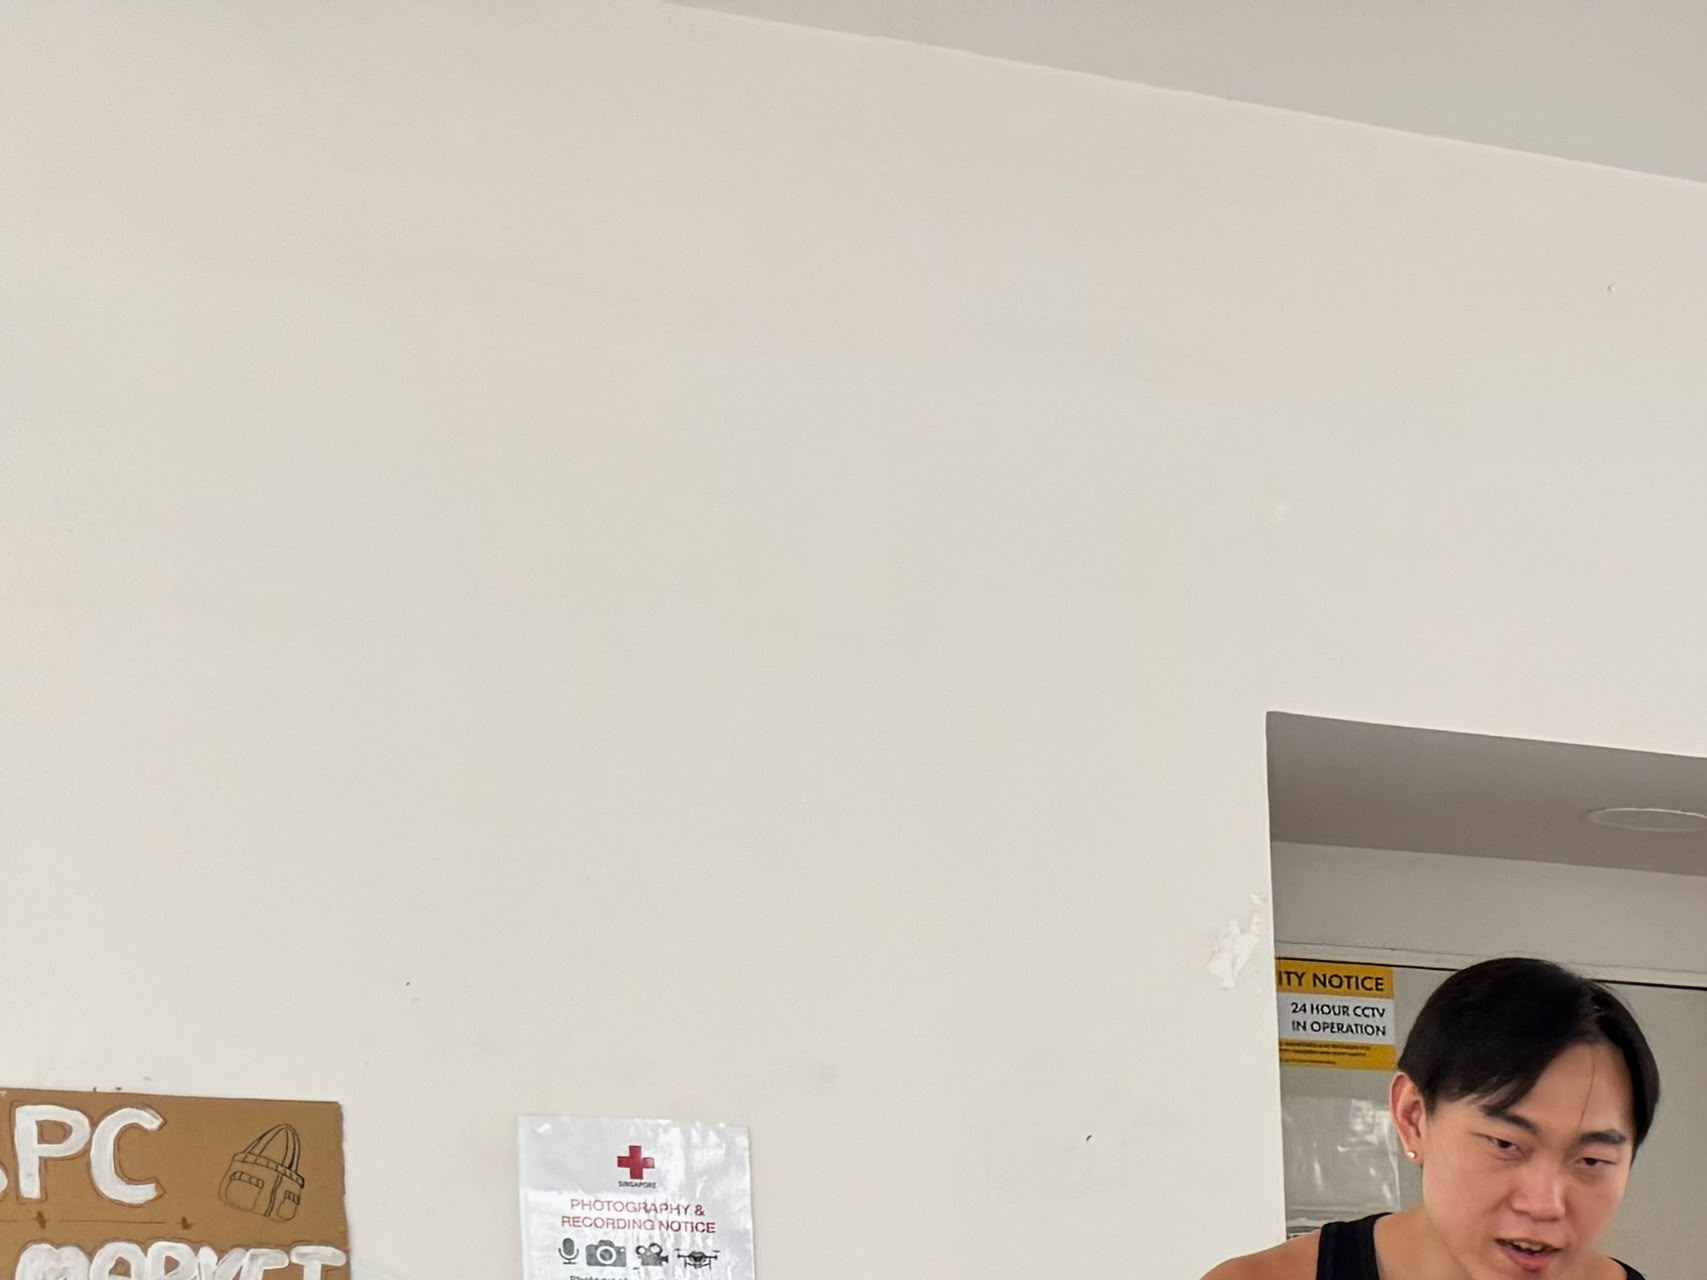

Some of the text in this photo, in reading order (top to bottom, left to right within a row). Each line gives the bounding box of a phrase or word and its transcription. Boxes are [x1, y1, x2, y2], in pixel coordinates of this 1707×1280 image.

[1278, 970, 1385, 992] ITY NOTICE
[1290, 1001, 1386, 1018] 24 HOUR CCTV
[1291, 1020, 1386, 1037] IN OPERATION
[0, 1104, 166, 1206] PC
[570, 1198, 706, 1217] PHOTOGRAPHY &
[561, 1215, 717, 1234] RECORDING NOTICE
